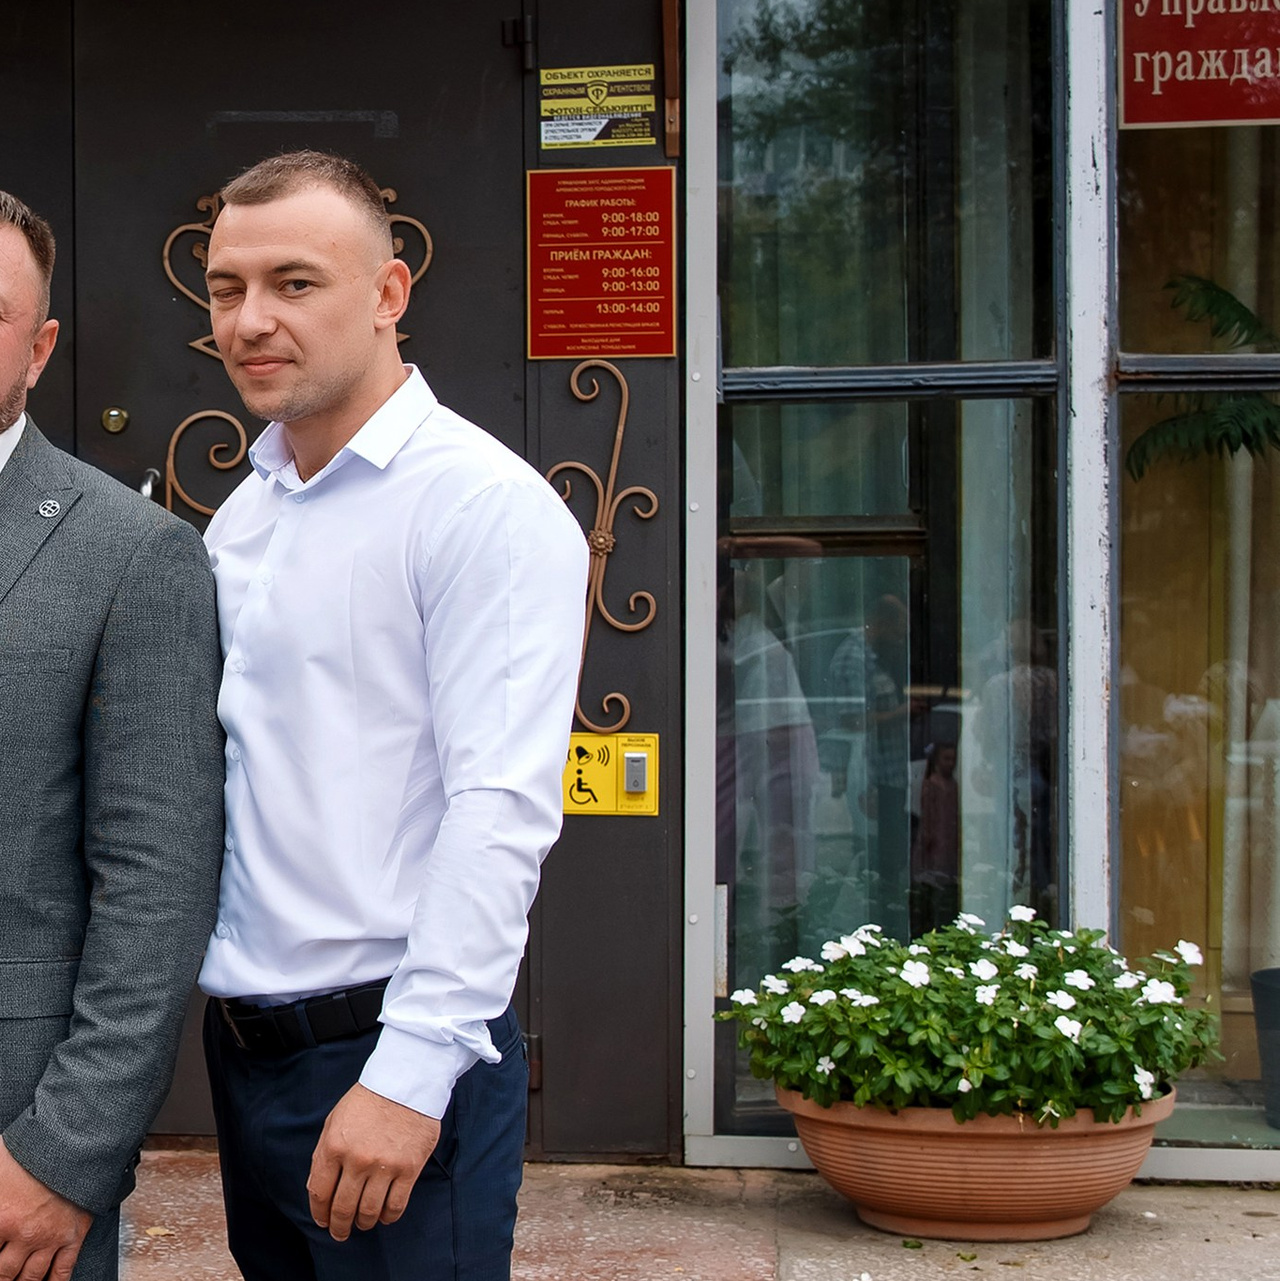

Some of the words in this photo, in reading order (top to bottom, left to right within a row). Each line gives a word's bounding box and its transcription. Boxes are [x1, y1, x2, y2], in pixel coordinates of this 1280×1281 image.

[545, 71, 585, 80] ОБЪЕКТ
[587, 68, 652, 79] ОХРАНЯЕТСЯ
[1133, 47, 1280, 95] гражда
[565, 199, 599, 208] ГРАФИК
[600, 198, 637, 207] РАБОТЫ:
[601, 211, 660, 223] 9:00-18:00
[601, 225, 660, 237] 9:00-17:00
[550, 248, 590, 261] ПРИЁМ
[592, 249, 652, 261] ГРАЖДАН:
[602, 266, 660, 278] 9:00-16:00
[602, 280, 660, 292] 9:00-13:00
[596, 302, 660, 314] 13:00-14:00
